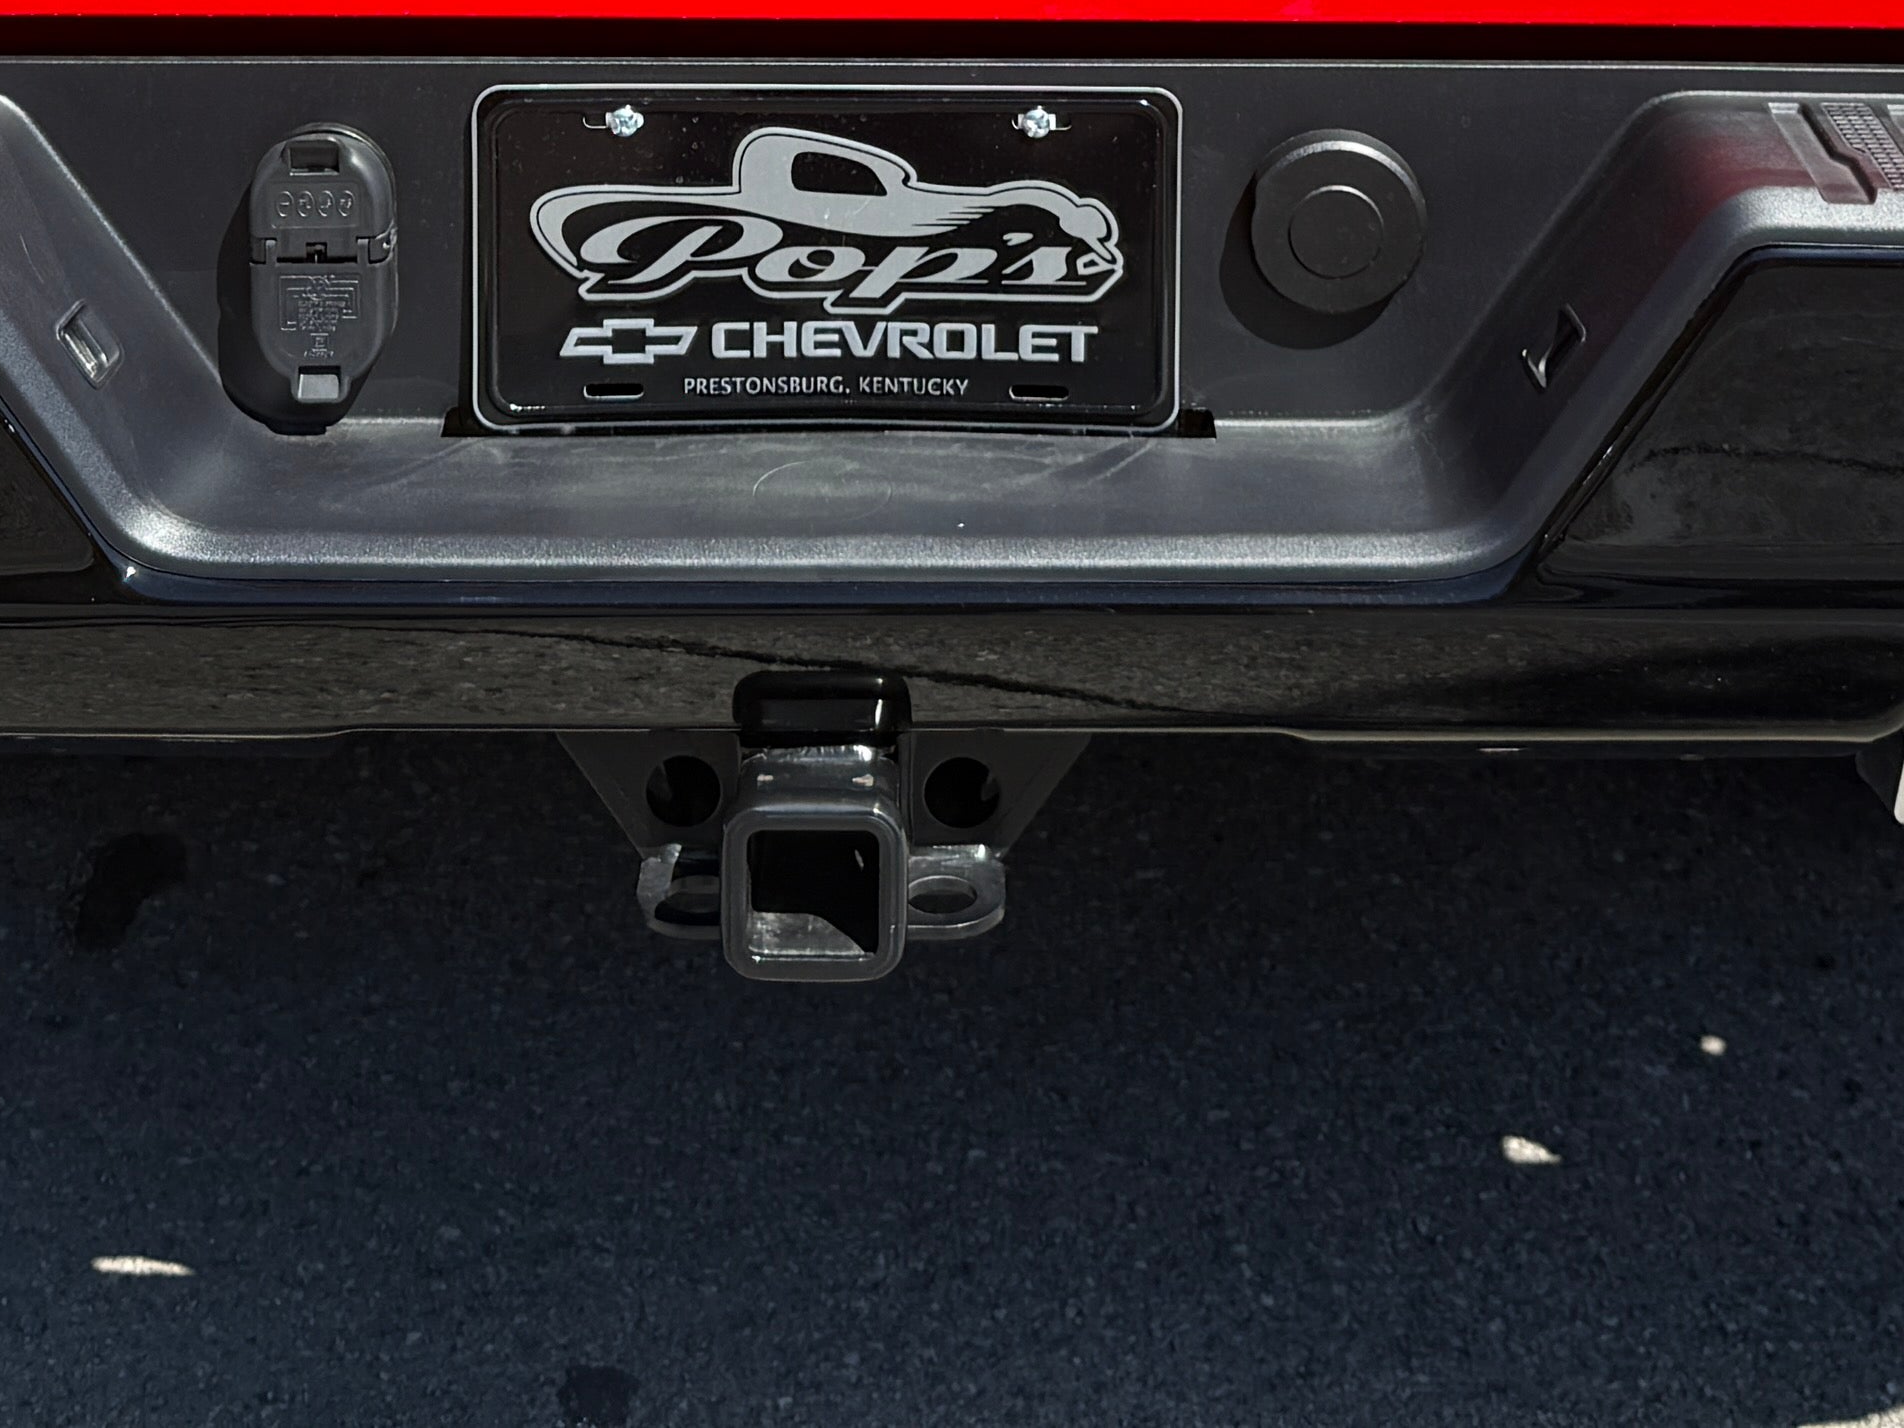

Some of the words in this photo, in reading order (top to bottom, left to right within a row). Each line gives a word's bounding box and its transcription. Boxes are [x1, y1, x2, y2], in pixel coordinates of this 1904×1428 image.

[579, 215, 1087, 299] Pop's
[711, 320, 1099, 363] CHEVROLET
[859, 377, 970, 397] KENTUCKY
